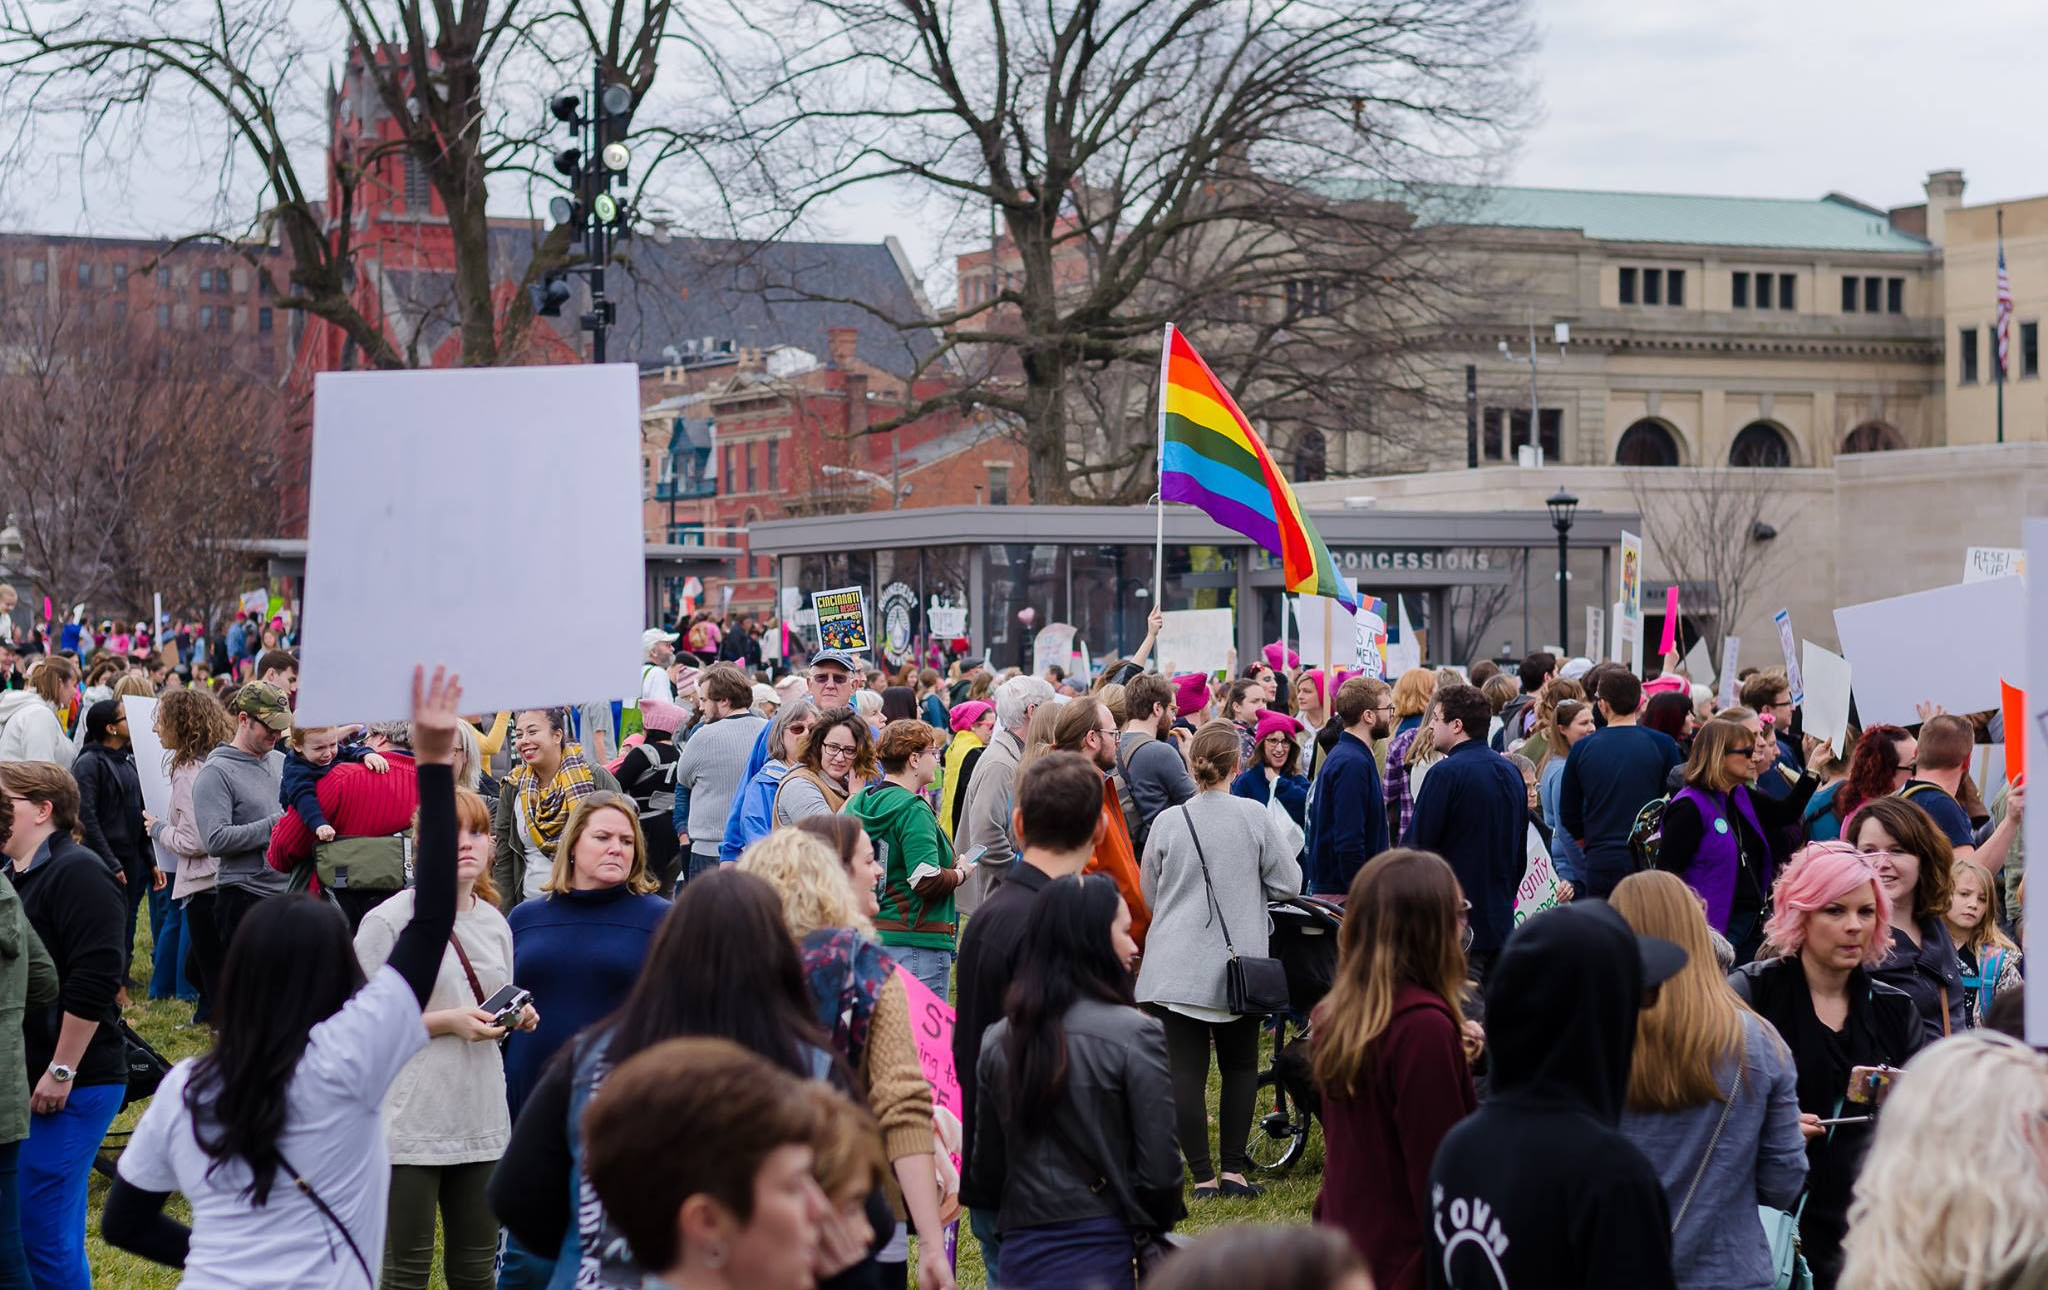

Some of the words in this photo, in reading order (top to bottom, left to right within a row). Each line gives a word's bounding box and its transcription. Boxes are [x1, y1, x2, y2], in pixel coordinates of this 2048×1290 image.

[1333, 551, 1490, 571] CONCESSIONS
[817, 591, 859, 608] CINCINNATI
[1514, 857, 1549, 909] ignity
